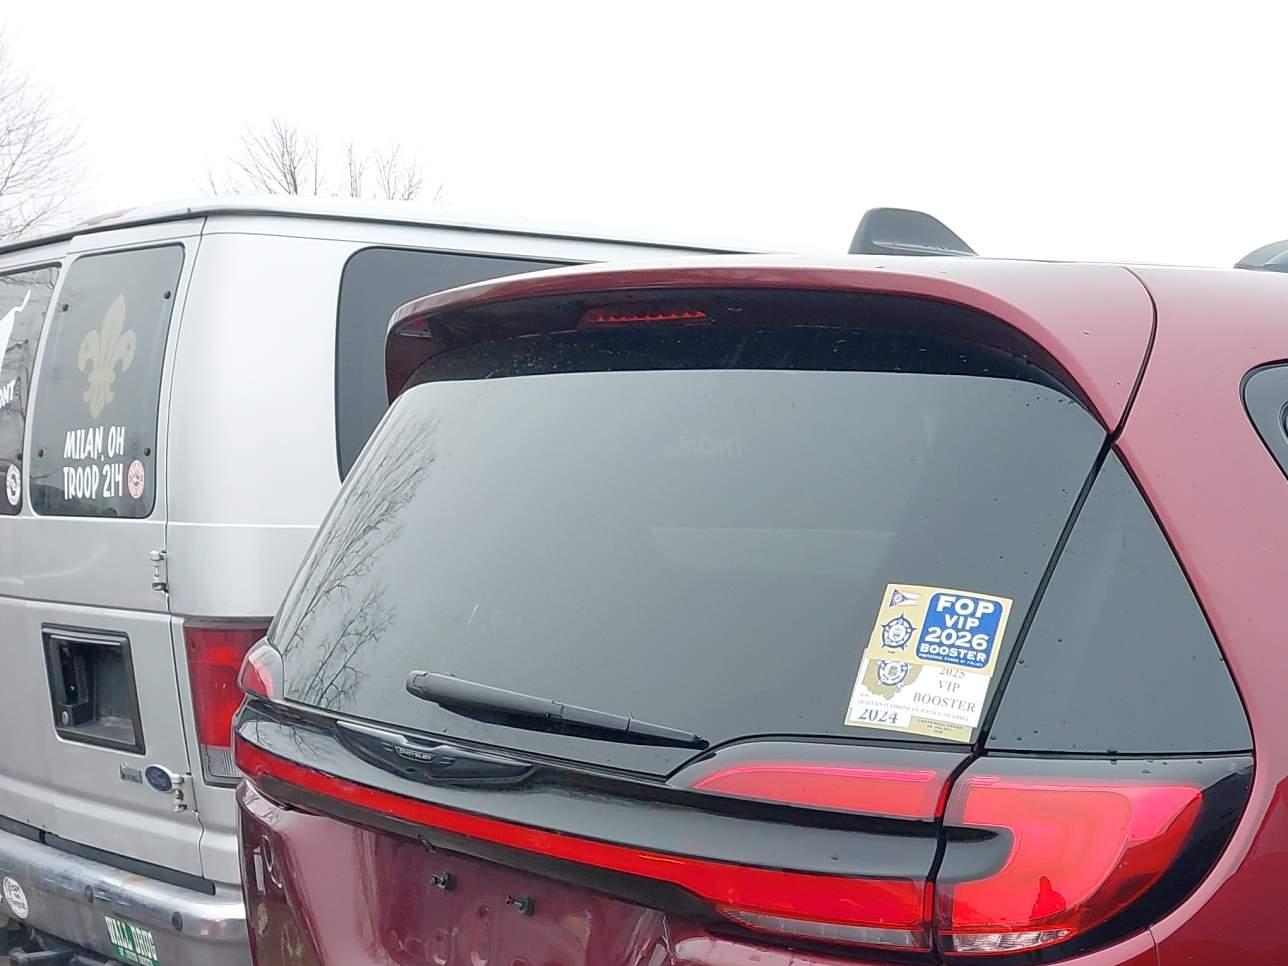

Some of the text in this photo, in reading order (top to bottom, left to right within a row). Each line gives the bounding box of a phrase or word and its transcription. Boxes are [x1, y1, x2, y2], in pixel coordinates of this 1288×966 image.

[64, 426, 125, 461] MILAN, OH
[63, 464, 99, 500] TROOP
[102, 463, 123, 497] 214
[936, 594, 995, 618] FOP
[944, 613, 980, 631] VIP
[924, 626, 990, 651] 2026
[919, 642, 987, 663] BOOSTER
[938, 680, 961, 693] VIP
[912, 692, 976, 713] BOOSTER
[858, 708, 899, 725] 2024
